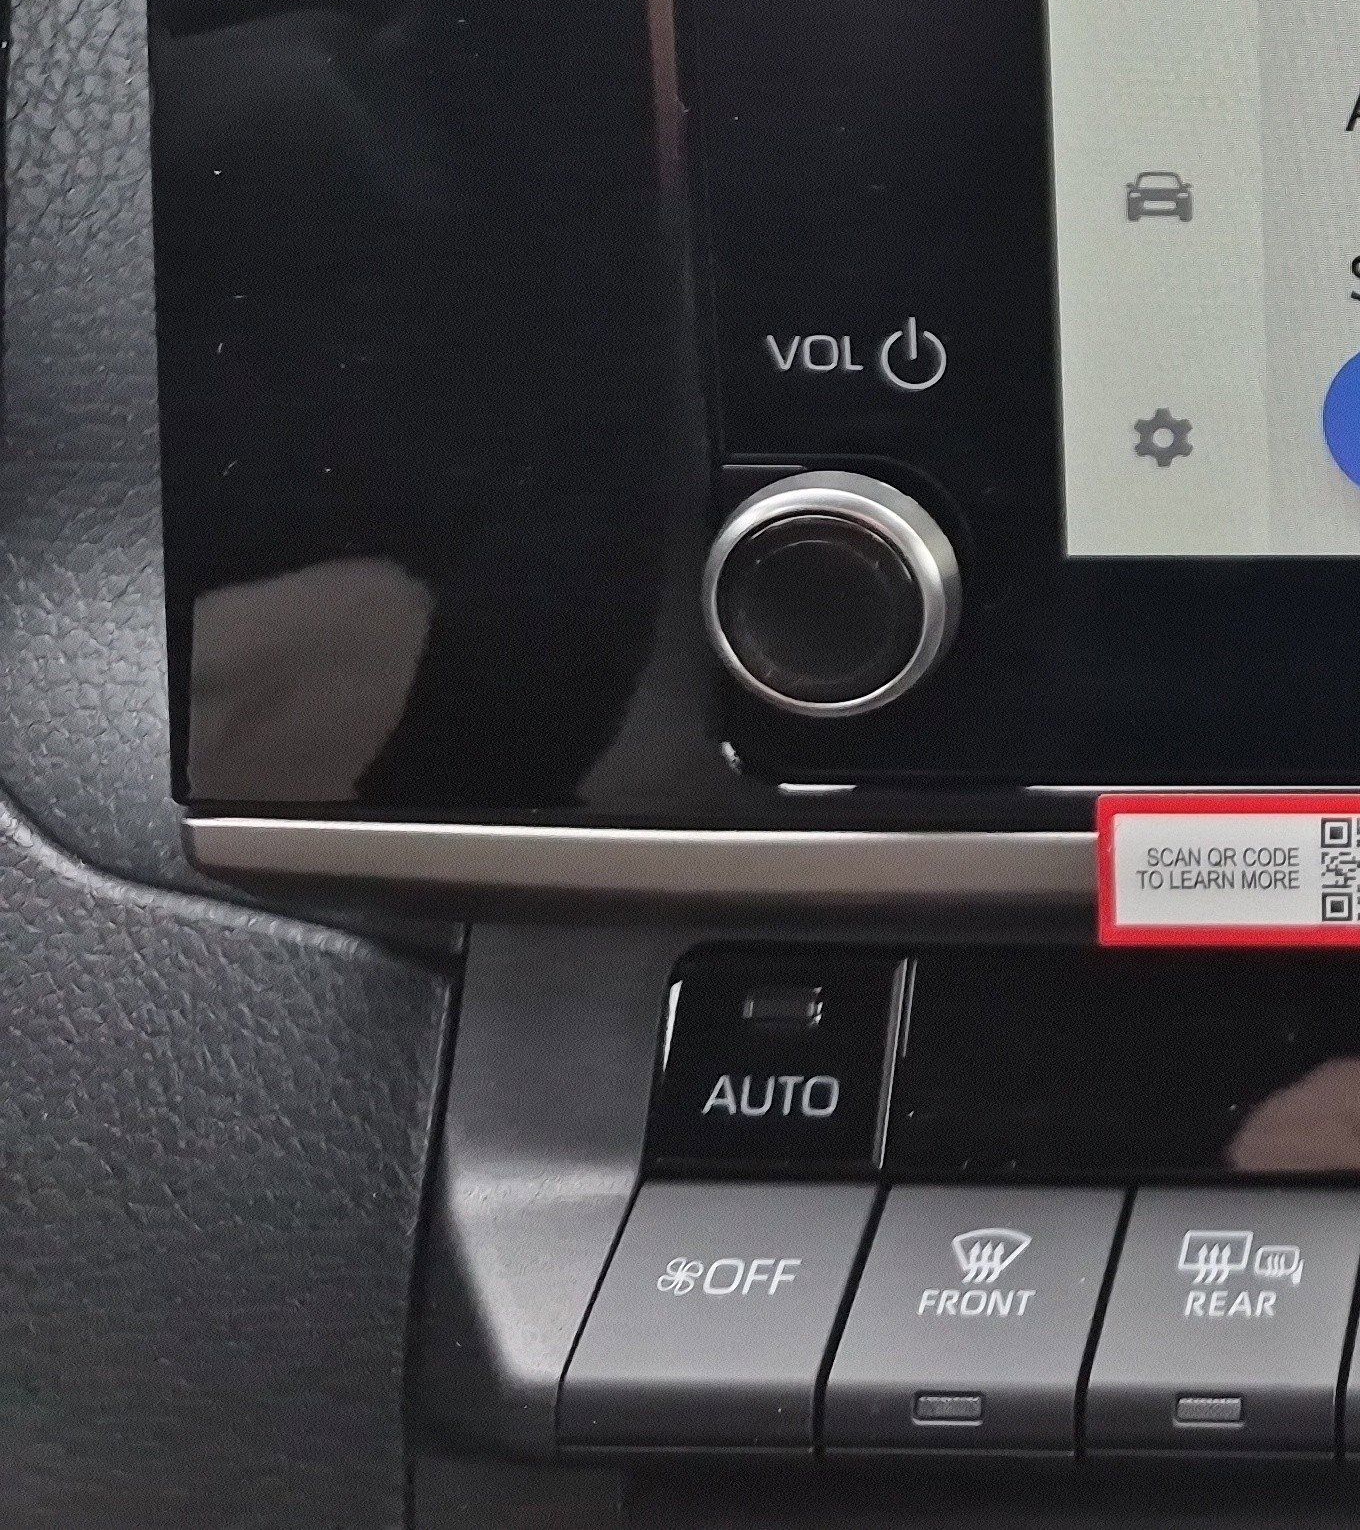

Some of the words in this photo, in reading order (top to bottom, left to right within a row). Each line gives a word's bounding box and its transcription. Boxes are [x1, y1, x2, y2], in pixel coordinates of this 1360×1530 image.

[766, 334, 864, 371] VOL
[1147, 847, 1201, 867] SCAN
[1207, 847, 1237, 867] QR
[1243, 847, 1299, 867] CODE
[1136, 871, 1163, 890] TO
[1169, 871, 1234, 890] LEARN
[1241, 871, 1300, 890] MORE
[702, 1075, 840, 1117] AUTO
[703, 1258, 801, 1295] OFF
[916, 1288, 1035, 1317] FRONT
[1184, 1289, 1277, 1317] REAR
